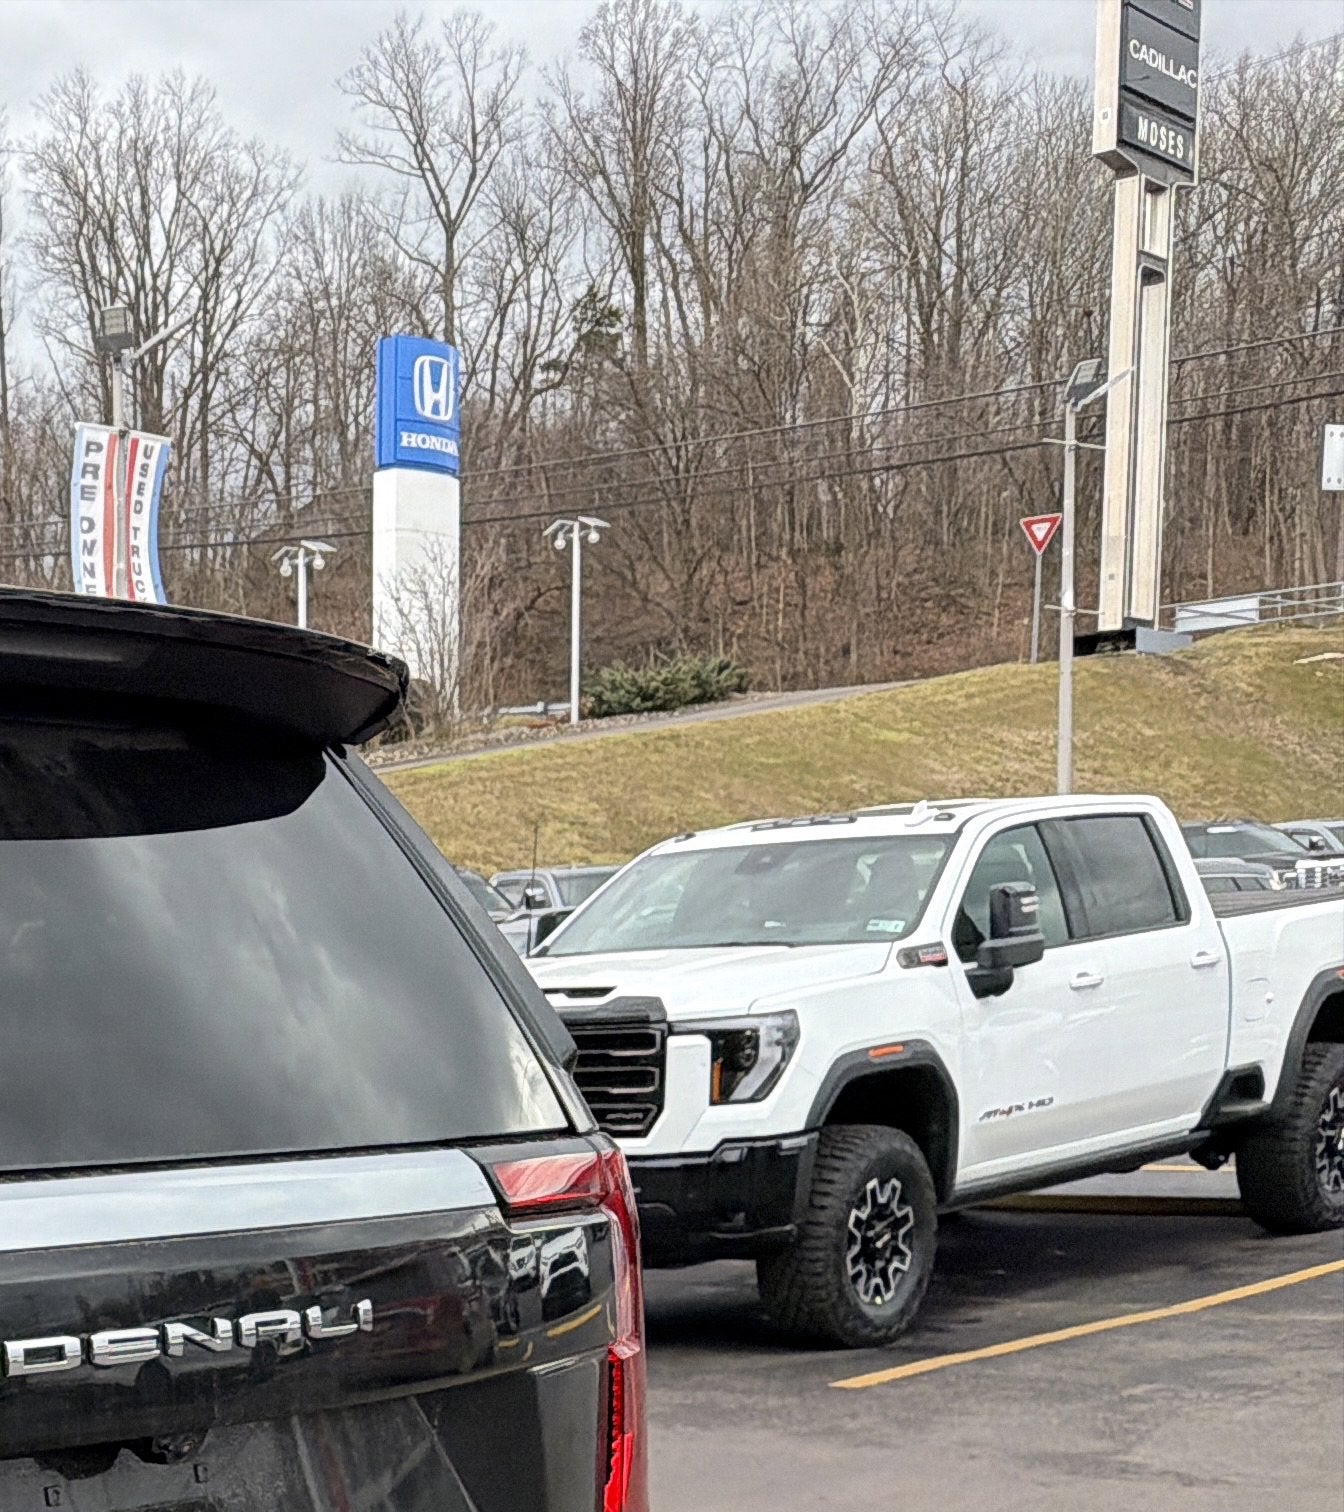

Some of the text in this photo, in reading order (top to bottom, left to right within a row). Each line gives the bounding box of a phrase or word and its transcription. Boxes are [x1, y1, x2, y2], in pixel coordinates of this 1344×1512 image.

[1129, 39, 1198, 89] CADILLAC
[1137, 115, 1185, 160] MOSES
[79, 440, 104, 502] PRE
[399, 430, 459, 457] HONDA
[130, 443, 155, 600] USED TRUC
[2, 1298, 374, 1378] DENALI
